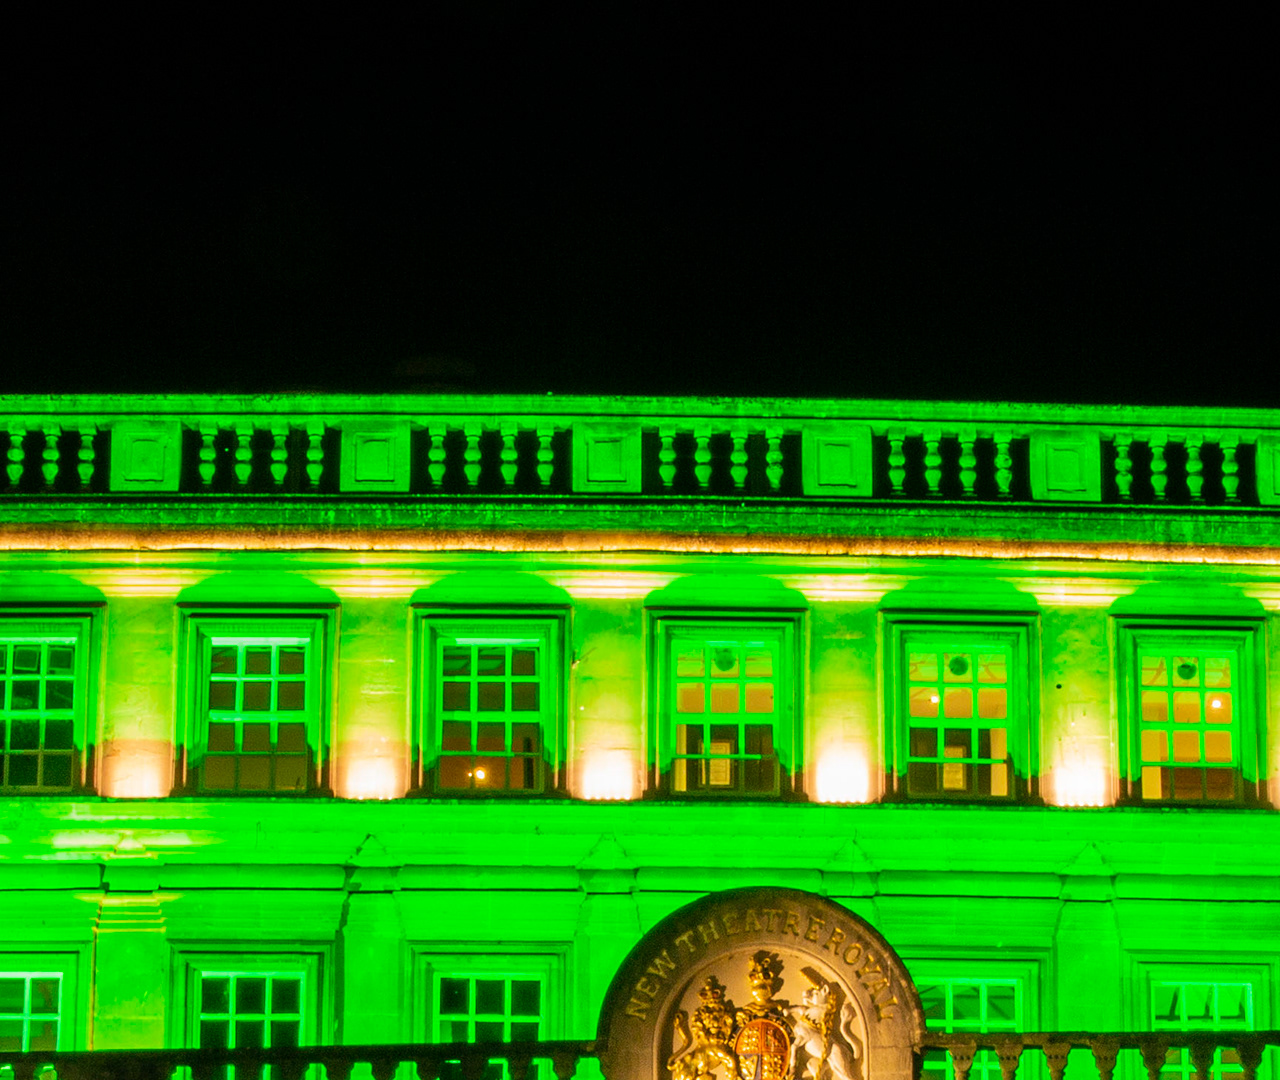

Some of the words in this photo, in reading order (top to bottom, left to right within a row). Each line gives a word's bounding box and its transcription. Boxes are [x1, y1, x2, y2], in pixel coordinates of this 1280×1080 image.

[625, 949, 676, 1021] NEW
[674, 908, 826, 953] THEATRE
[822, 927, 899, 1023] ROYAL
